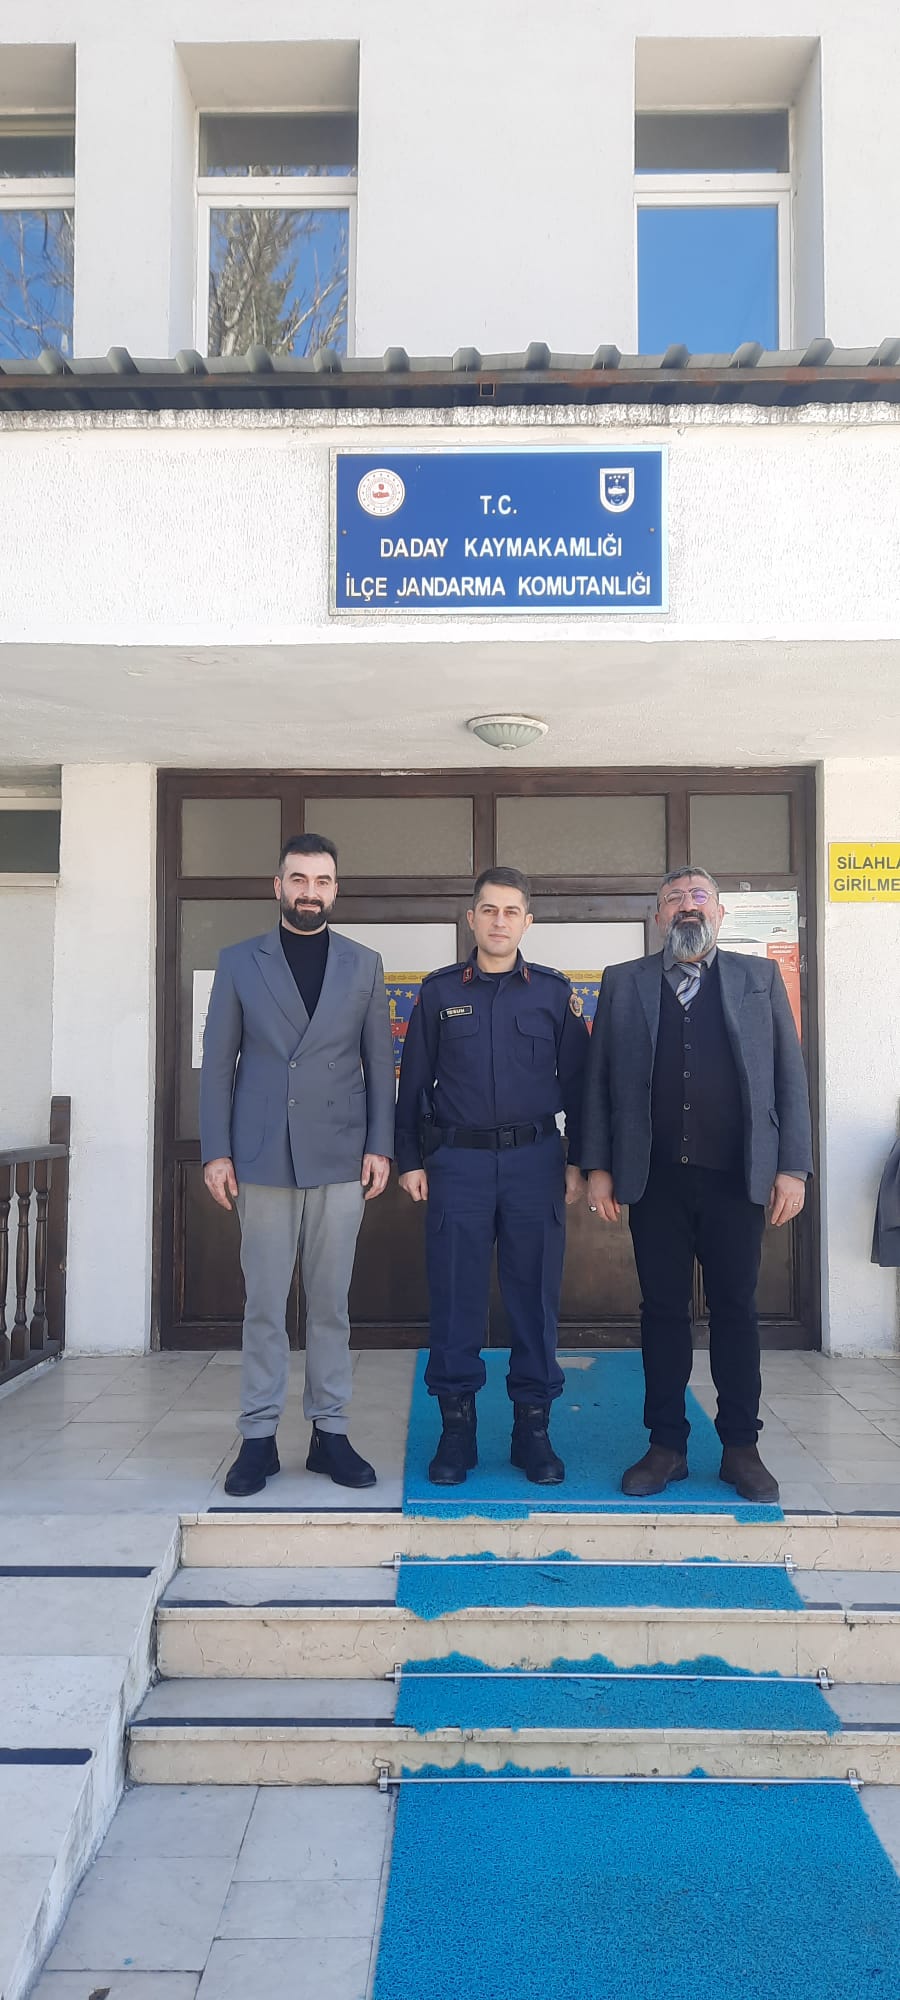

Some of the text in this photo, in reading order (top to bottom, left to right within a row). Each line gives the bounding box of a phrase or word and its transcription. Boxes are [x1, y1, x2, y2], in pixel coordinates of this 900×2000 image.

[480, 495, 517, 514] T.C.
[381, 533, 622, 557] DADAY KAYMAKAMLIĞI
[346, 572, 651, 602] İLÇE JANDARMA KOMUTANLIĞI
